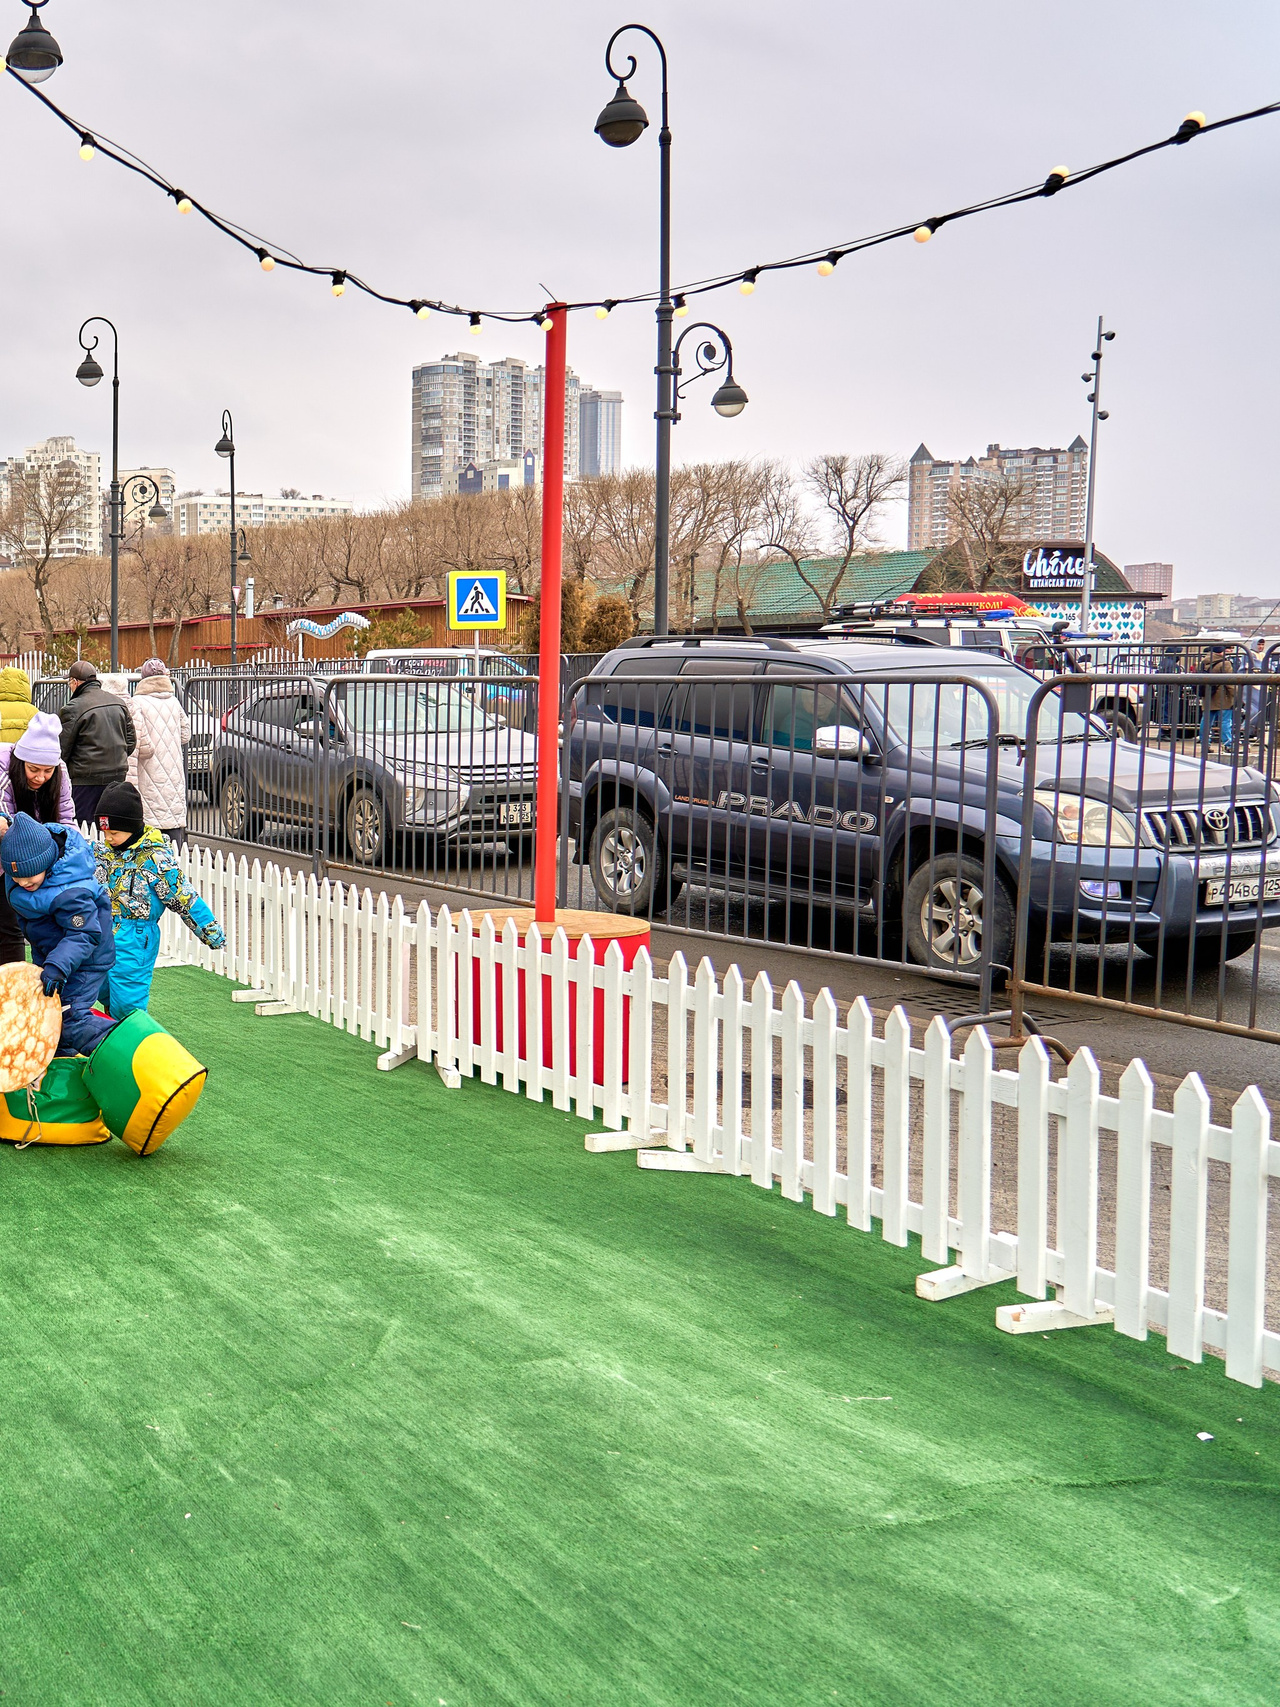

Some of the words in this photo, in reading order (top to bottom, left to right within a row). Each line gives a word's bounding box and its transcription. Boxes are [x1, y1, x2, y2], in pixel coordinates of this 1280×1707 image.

[1065, 613, 1076, 621] 165
[674, 794, 690, 802] LAND
[716, 790, 878, 833] PRADO
